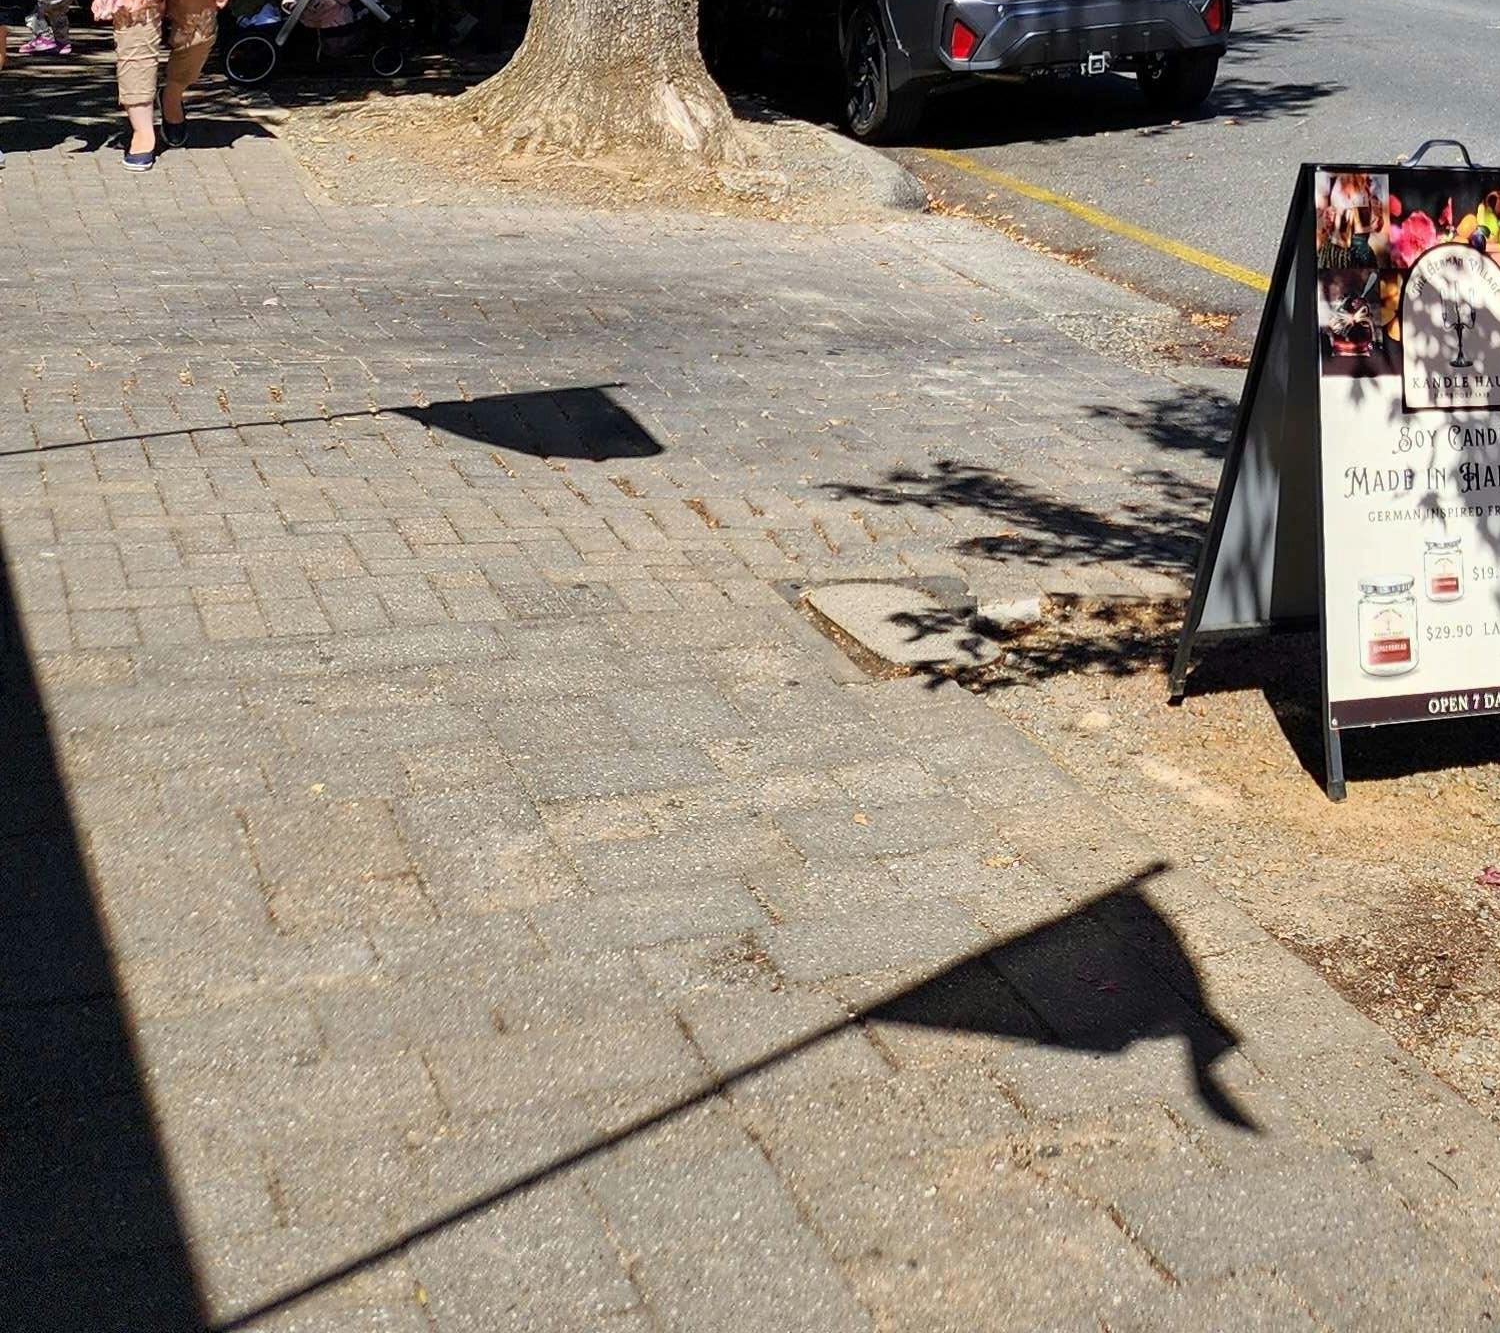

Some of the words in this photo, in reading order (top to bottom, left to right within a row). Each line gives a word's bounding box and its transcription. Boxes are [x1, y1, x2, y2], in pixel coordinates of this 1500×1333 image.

[1412, 376, 1469, 389] KANDLE
[1391, 426, 1439, 455] SOY
[1343, 465, 1416, 499] MADE
[1426, 467, 1447, 492] IN
[1368, 508, 1421, 523] GERMAN
[1423, 505, 1484, 520] INSPIRED
[1426, 624, 1473, 641] $29.90
[1428, 694, 1469, 714] OPEN
[1472, 693, 1480, 710] 7
